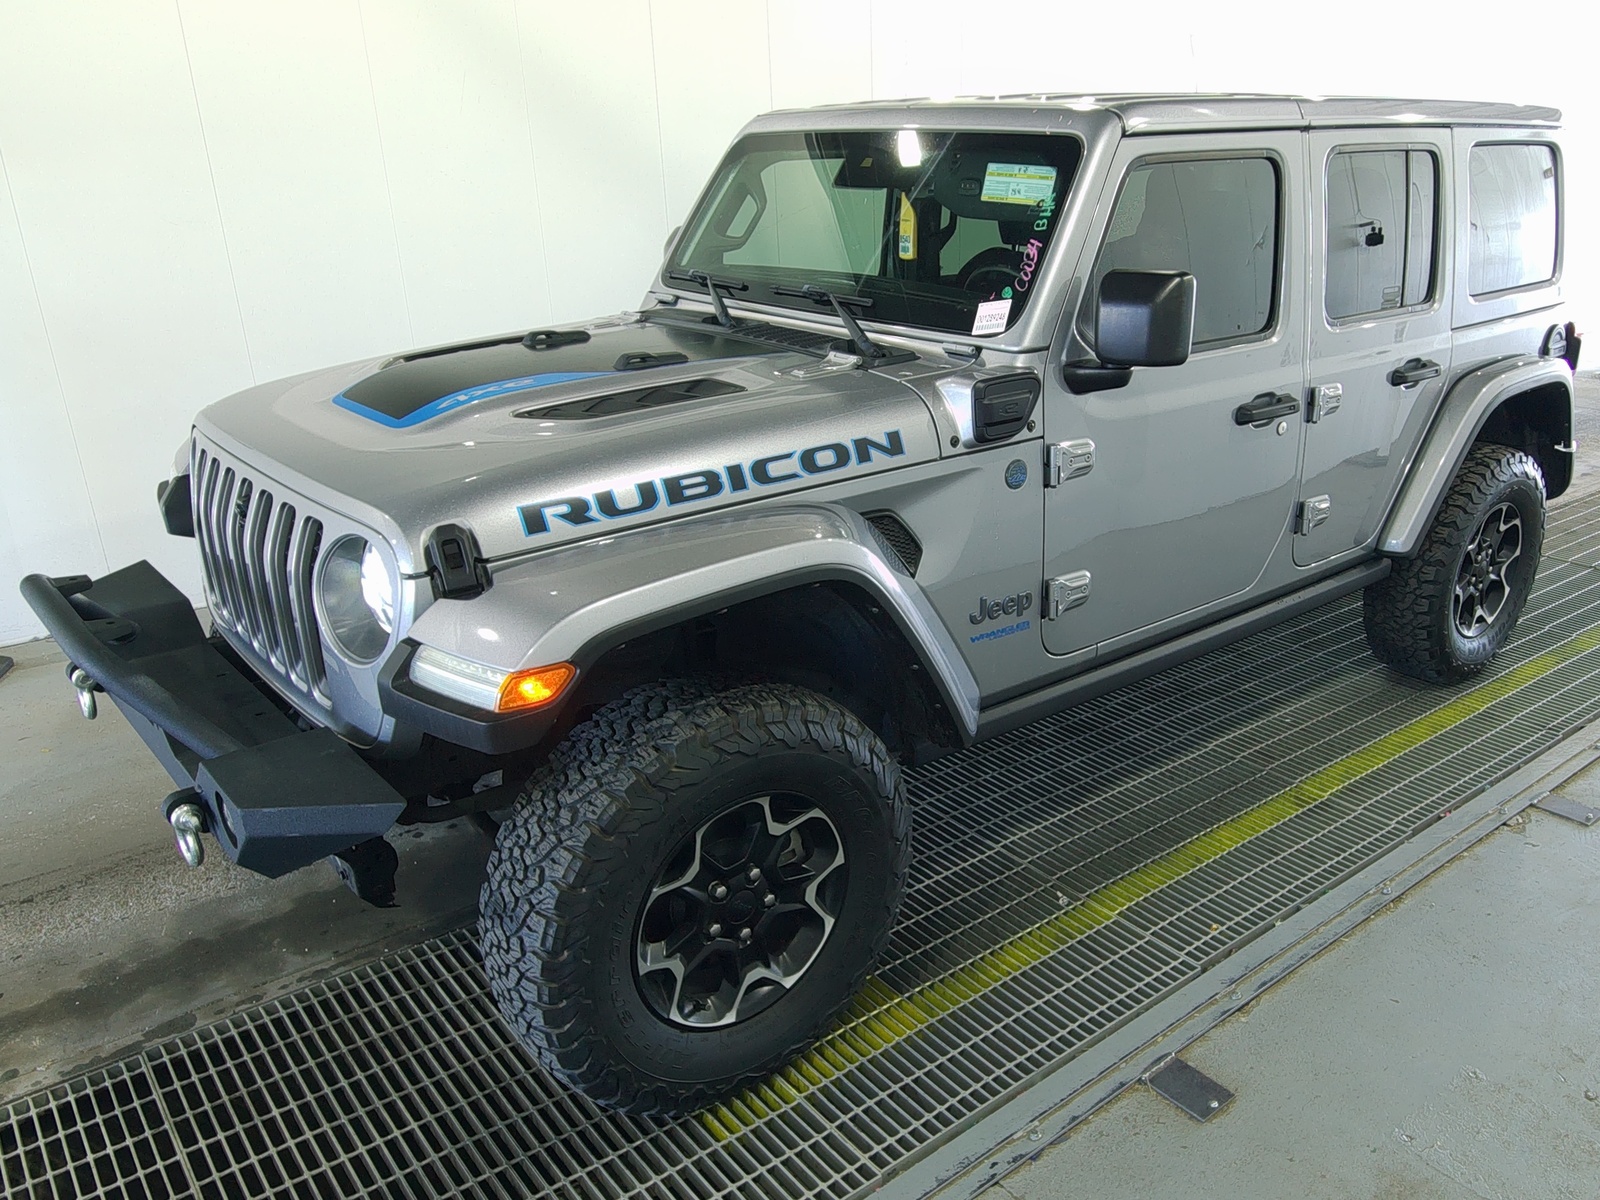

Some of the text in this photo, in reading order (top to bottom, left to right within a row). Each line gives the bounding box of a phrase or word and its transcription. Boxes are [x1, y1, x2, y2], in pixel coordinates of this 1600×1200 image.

[516, 429, 906, 537] RUBICON
[969, 590, 1033, 625] Jeep
[969, 620, 1031, 643] WRANGLER
